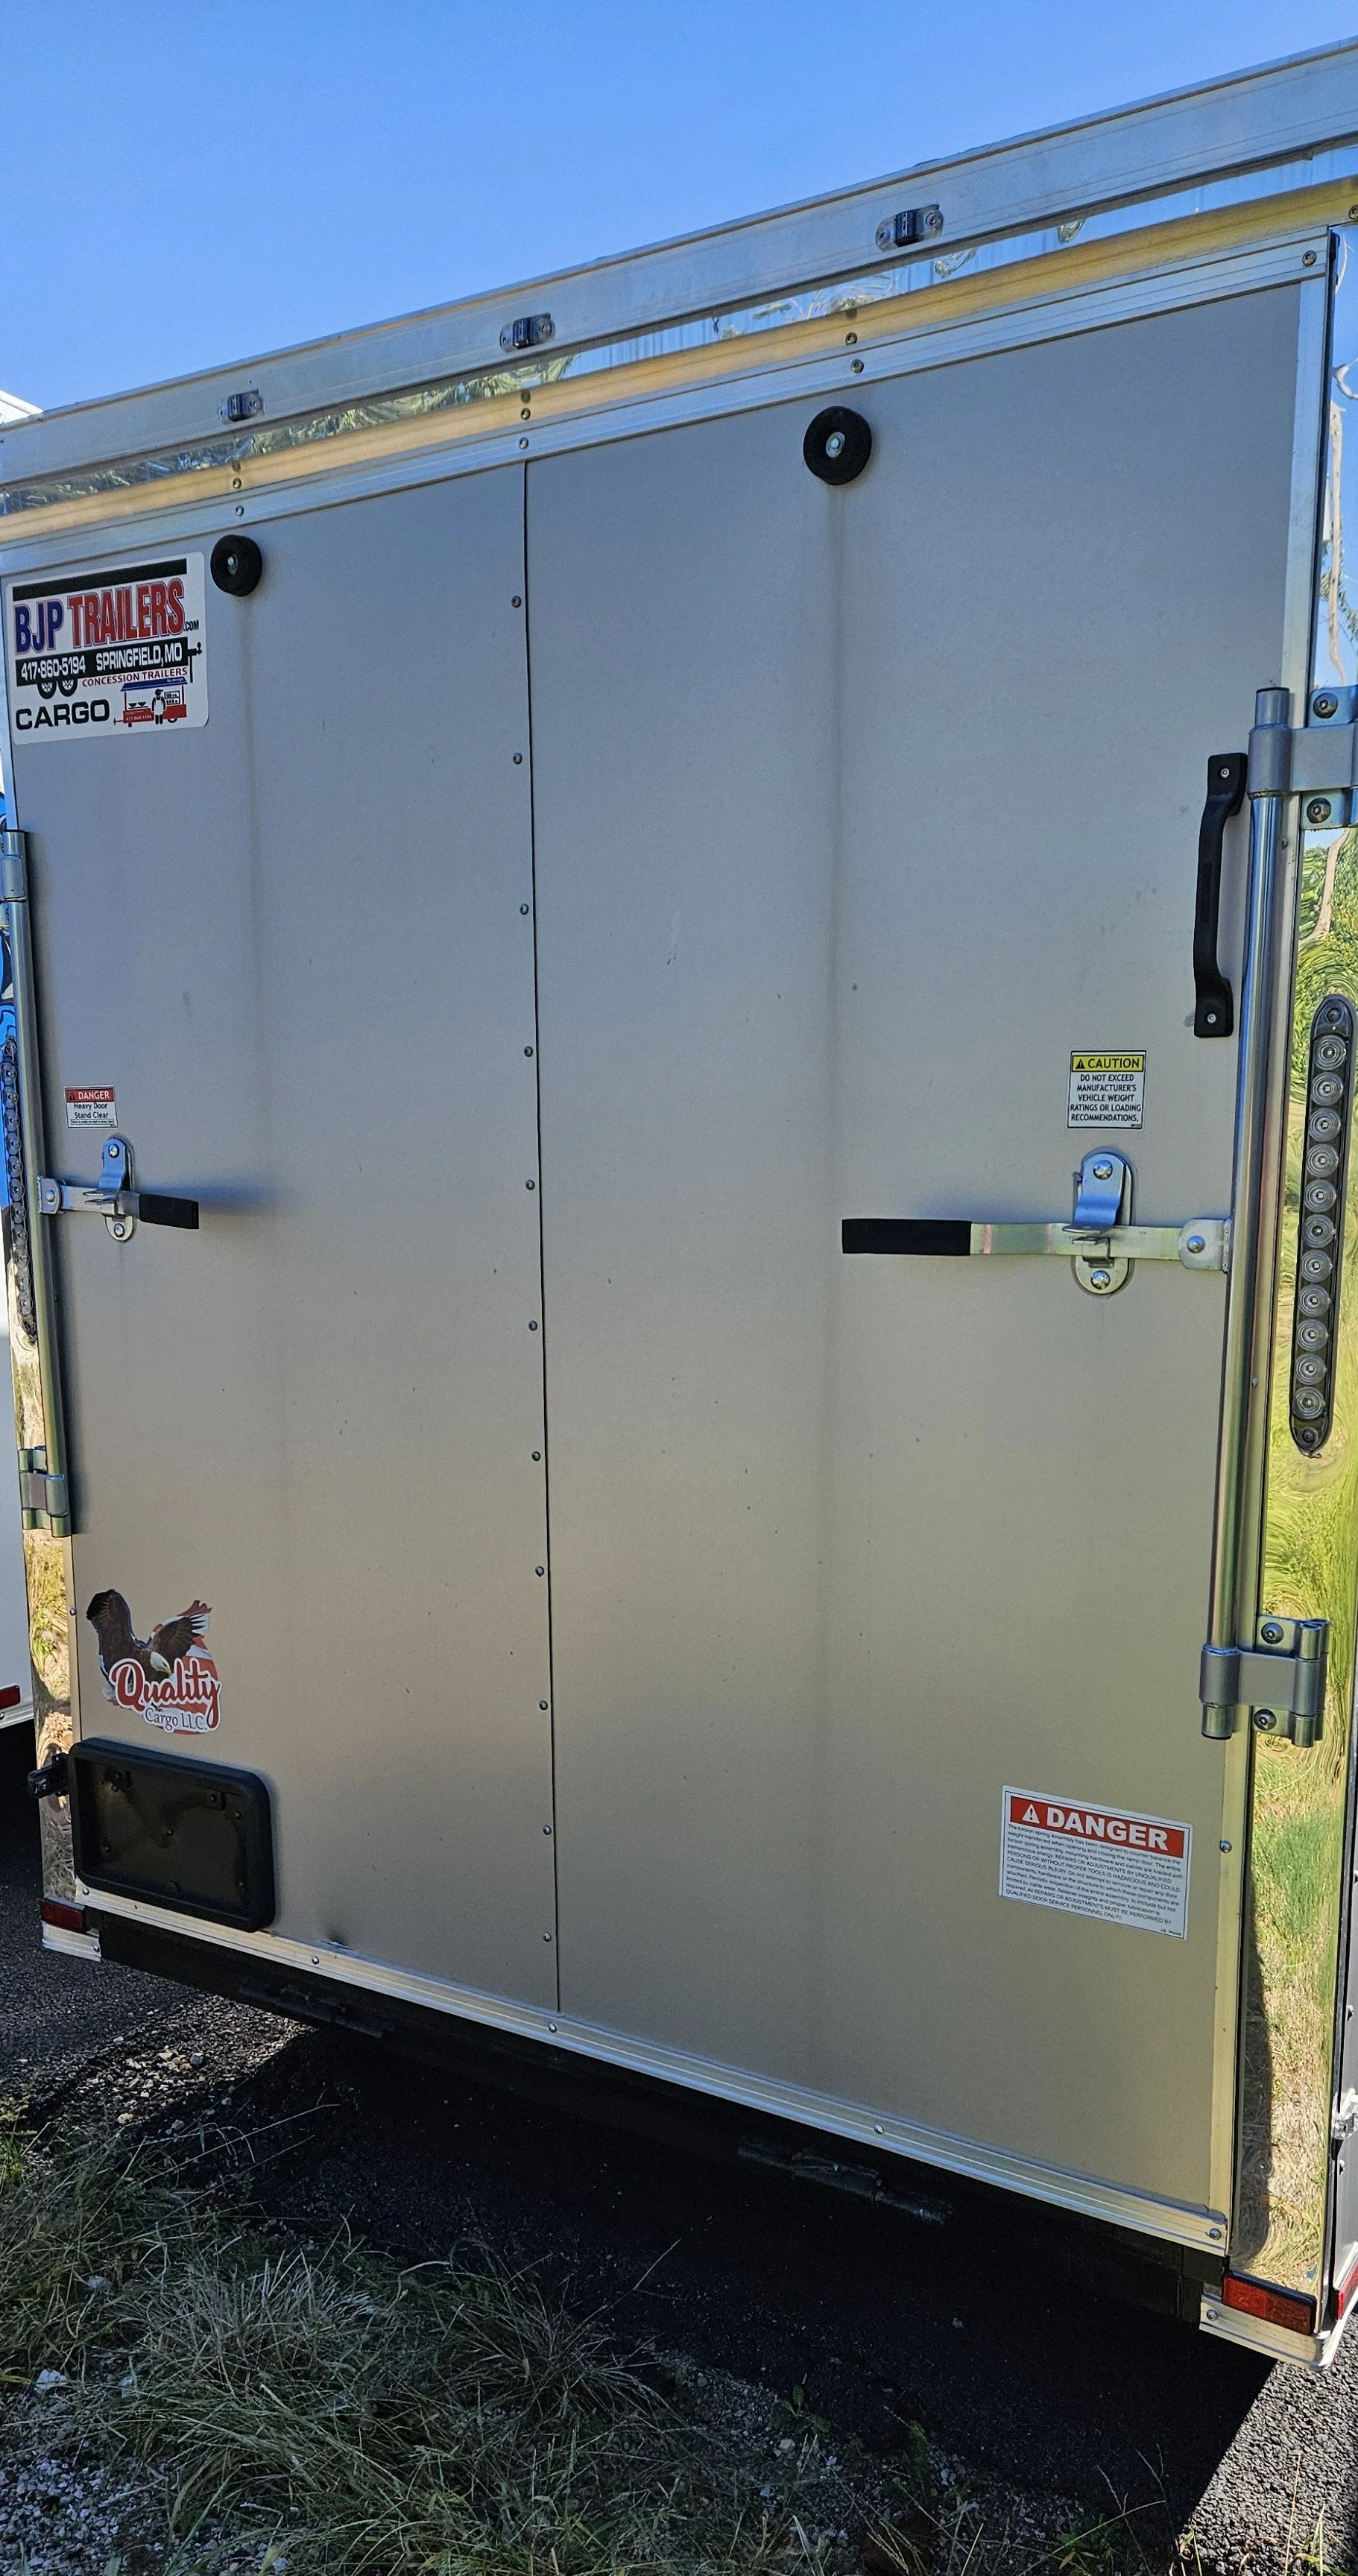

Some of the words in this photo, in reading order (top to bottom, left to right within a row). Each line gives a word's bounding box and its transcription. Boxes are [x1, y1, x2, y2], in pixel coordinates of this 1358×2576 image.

[13, 599, 64, 655] BJP
[68, 578, 185, 648] TRAILERS
[165, 643, 182, 661] MO
[82, 673, 139, 687] CONCESSION
[142, 667, 188, 680] TRAILERS
[16, 699, 110, 730] CARGO
[1088, 1058, 1140, 1068] CAUTION
[78, 1090, 110, 1099] DANGER
[1071, 1114, 1139, 1122] RECOMMENDATIONS.
[111, 1659, 221, 1729] Quality
[145, 1708, 178, 1731] Cargo
[1046, 1807, 1168, 1851] DANGER
[1007, 1856, 1023, 1864] CAUSE
[1024, 1860, 1046, 1869] SERIOUS
[1007, 1850, 1031, 1859] PERSONS
[1040, 1857, 1064, 1866] WITHOUT
[1065, 1863, 1086, 1872] PROPER
[1113, 1873, 1146, 1885] HAZARDOUS
[1160, 1884, 1179, 1892] COULD
[1055, 1854, 1076, 1863] REPAIRS
[1087, 1861, 1125, 1874] ADJUSTMENTS
[1135, 1872, 1171, 1884] UNQUALIFIED
[1005, 1889, 1032, 1899] QUALIFIED
[1049, 1898, 1069, 1907] SERVICE
[1071, 1904, 1103, 1916] PERSONNEL
[1035, 1889, 1055, 1898] REPAIRS
[1065, 1896, 1103, 1909] ADJUSTMENTS
[1129, 1911, 1163, 1923] PERFORMED
